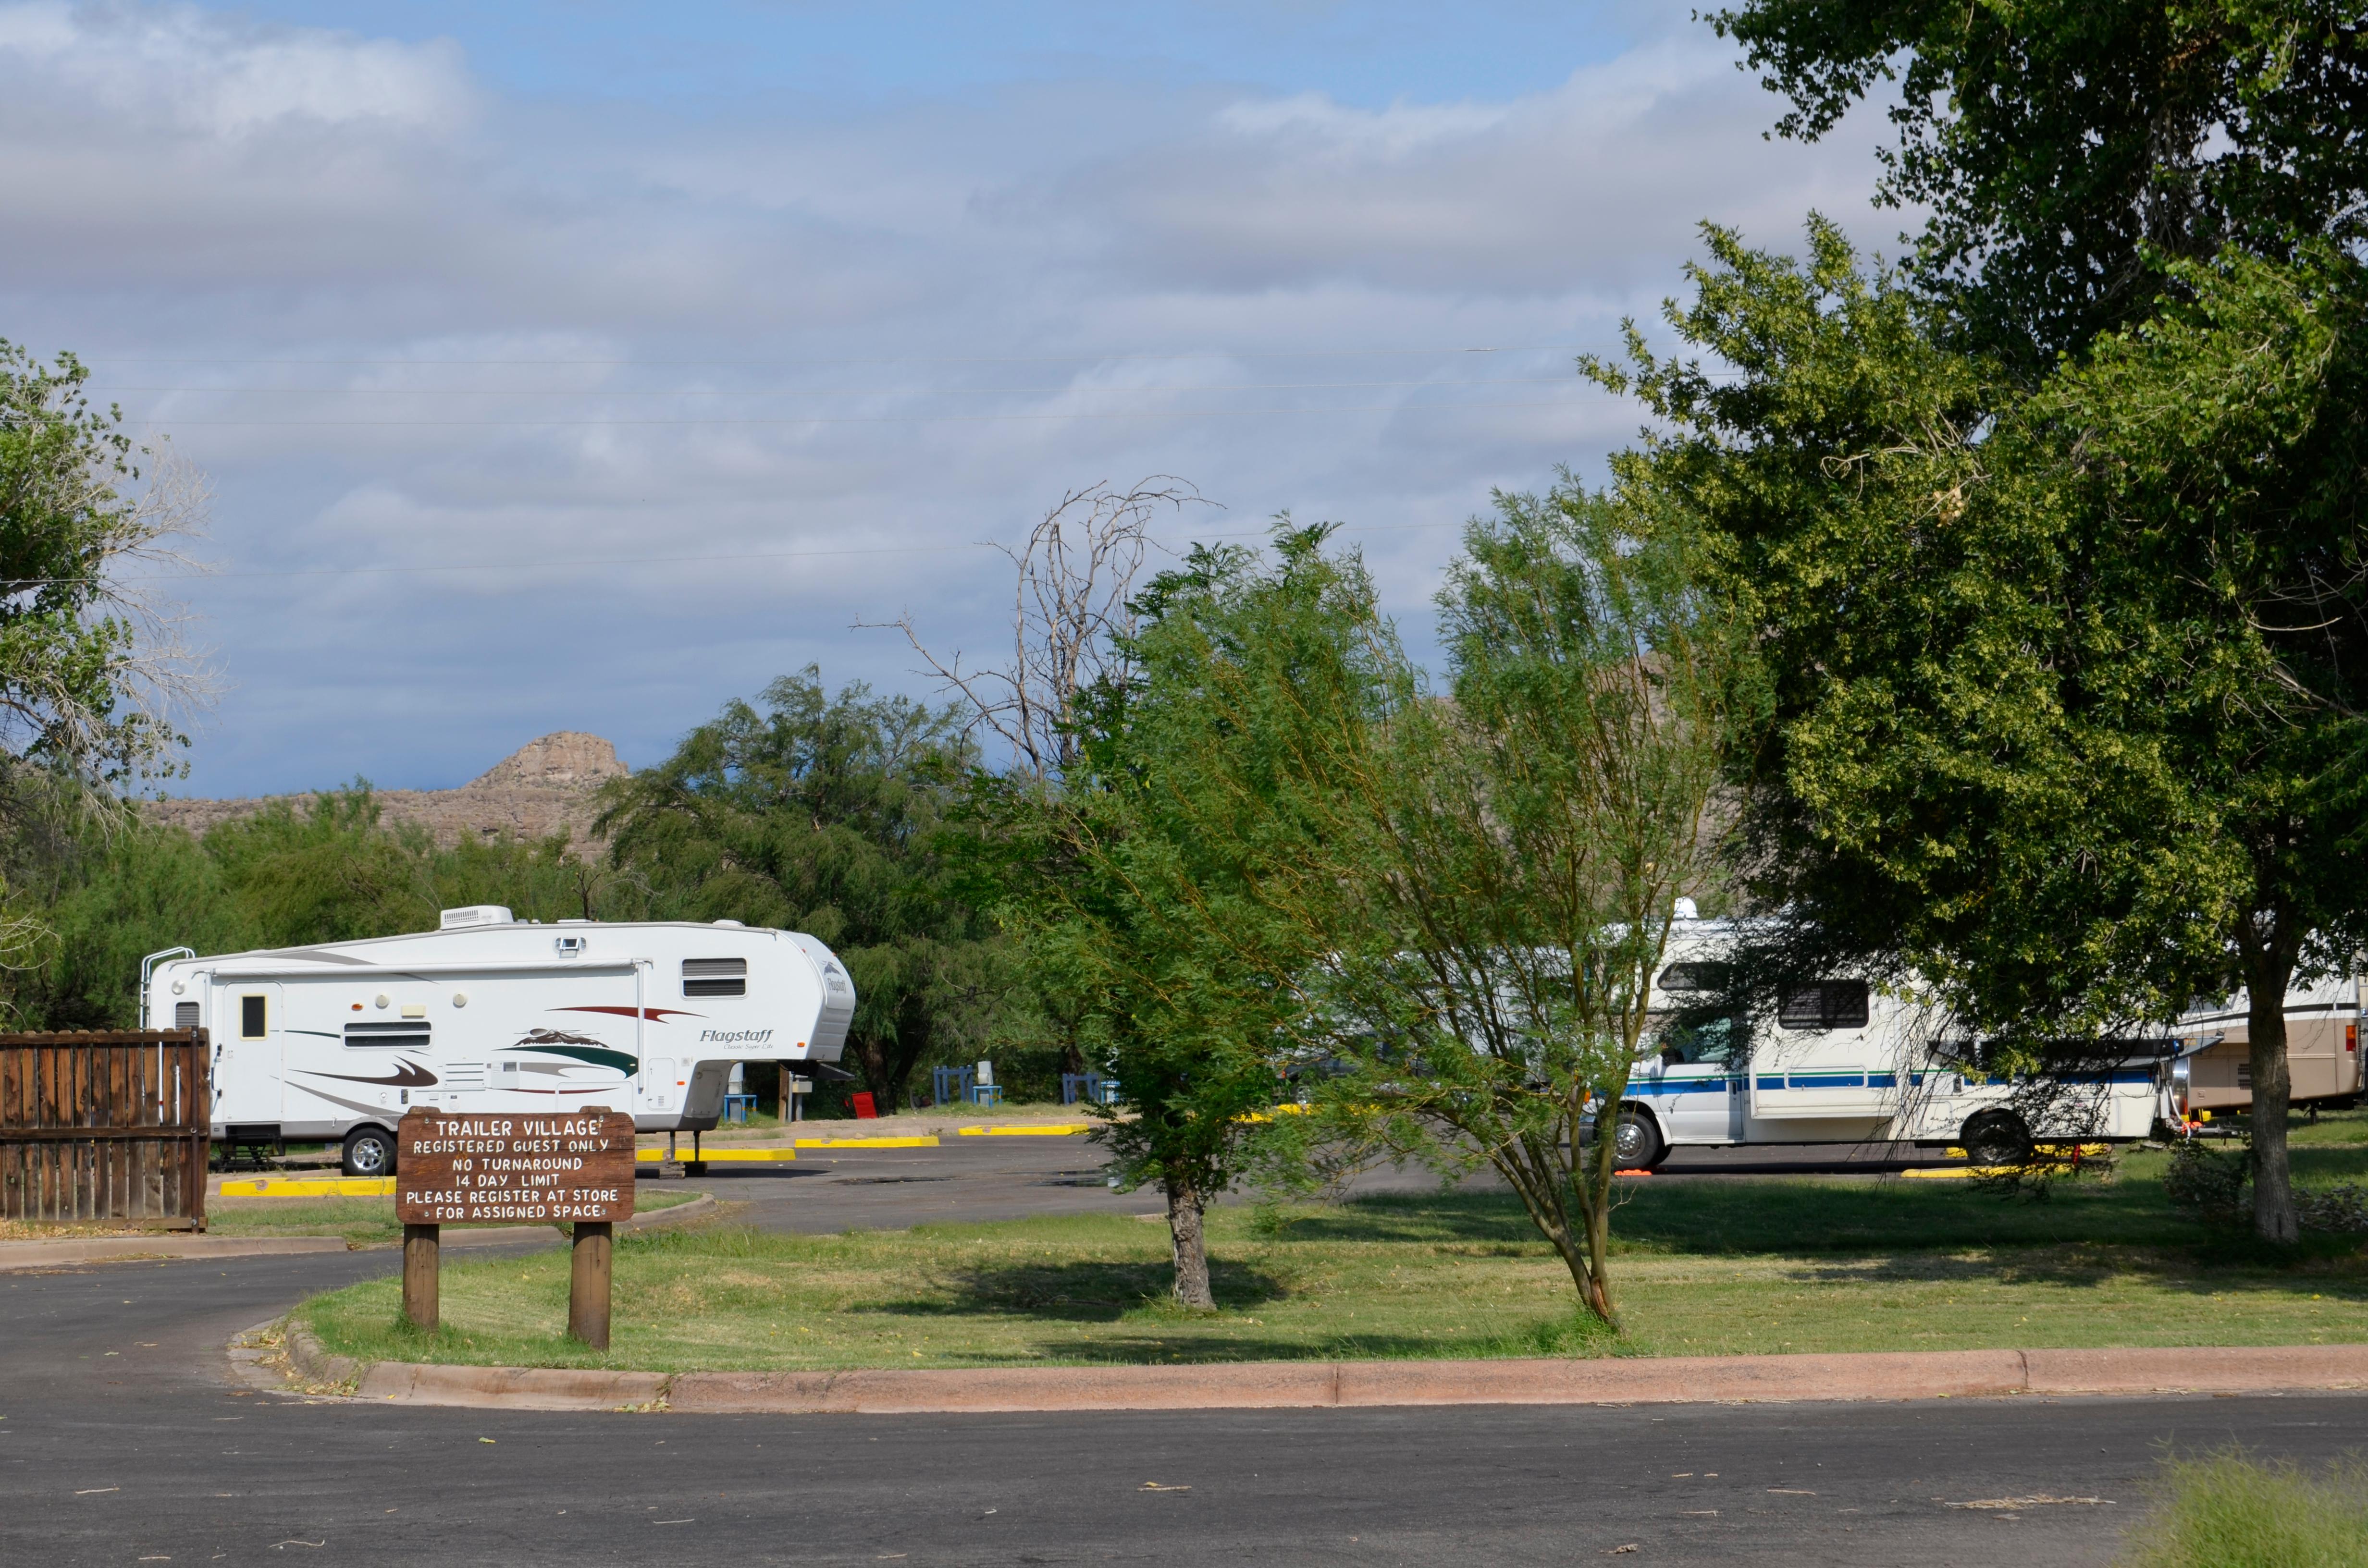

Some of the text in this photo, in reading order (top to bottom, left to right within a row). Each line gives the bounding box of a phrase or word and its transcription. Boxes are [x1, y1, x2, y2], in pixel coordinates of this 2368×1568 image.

[827, 978, 846, 993] Flagstaff
[700, 1029, 774, 1043] Flagstaff
[436, 1119, 598, 1136] TRAILER VILLAGE
[414, 1139, 608, 1153] REGISTERED GUEST ONLY
[453, 1157, 582, 1171] NO TURNAROUND
[456, 1174, 559, 1187] 14 DAY LIMIT
[407, 1189, 618, 1204] PLEASE REGISTER AT STORE
[436, 1204, 600, 1219] FOR ASSIGNED SPACE
